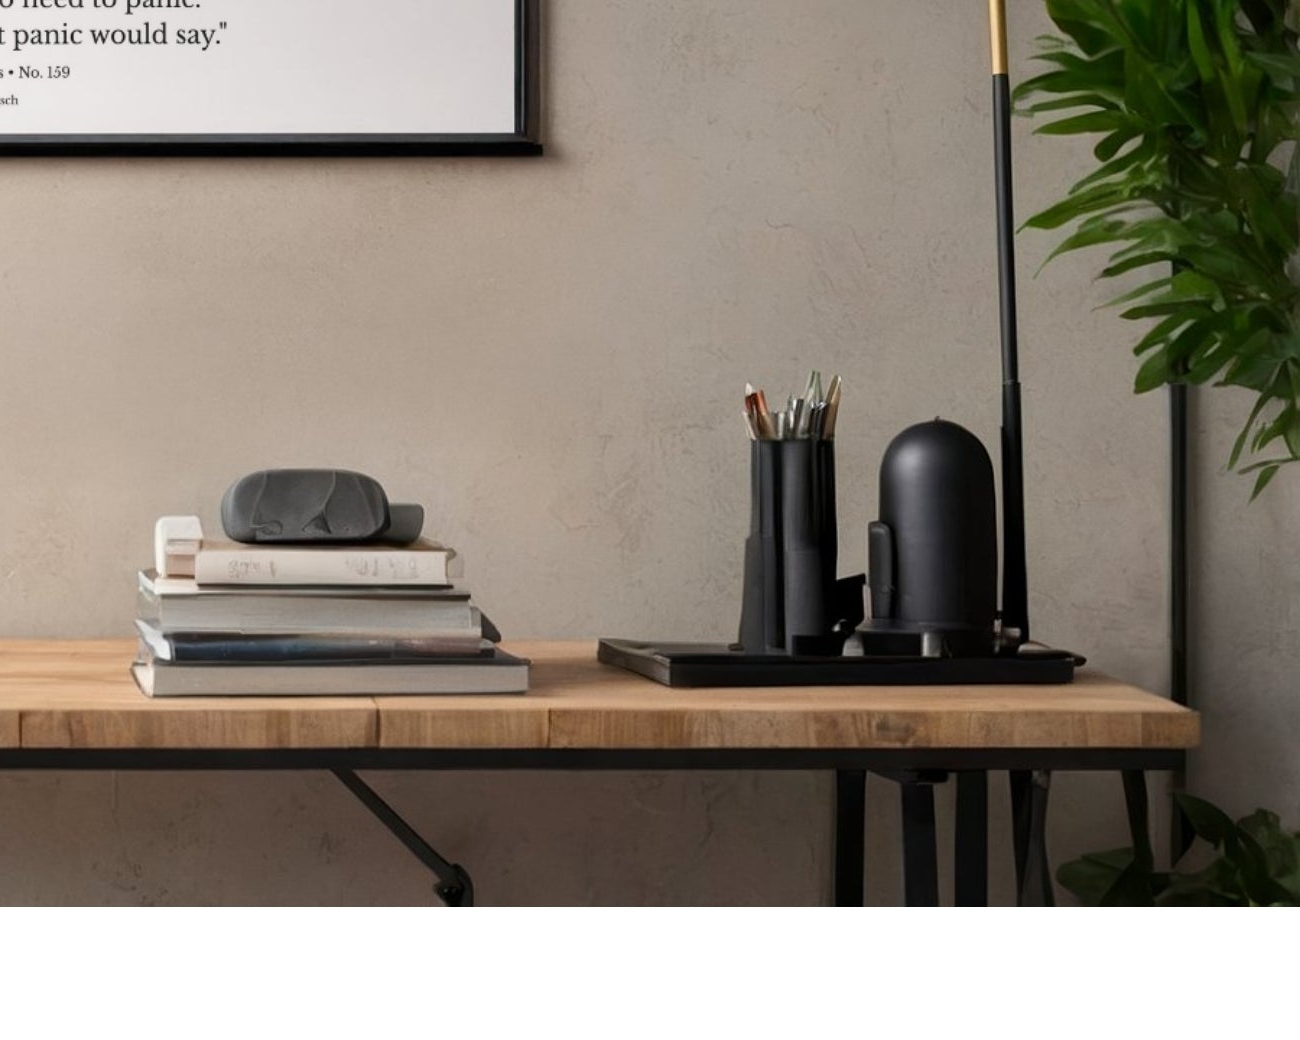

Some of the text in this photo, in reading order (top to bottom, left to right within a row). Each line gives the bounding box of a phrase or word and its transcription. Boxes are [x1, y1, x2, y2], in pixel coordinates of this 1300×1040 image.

[12, 23, 84, 51] panic
[89, 21, 169, 45] would
[175, 21, 228, 51] say."
[18, 66, 43, 78] No.
[47, 66, 71, 78] 159
